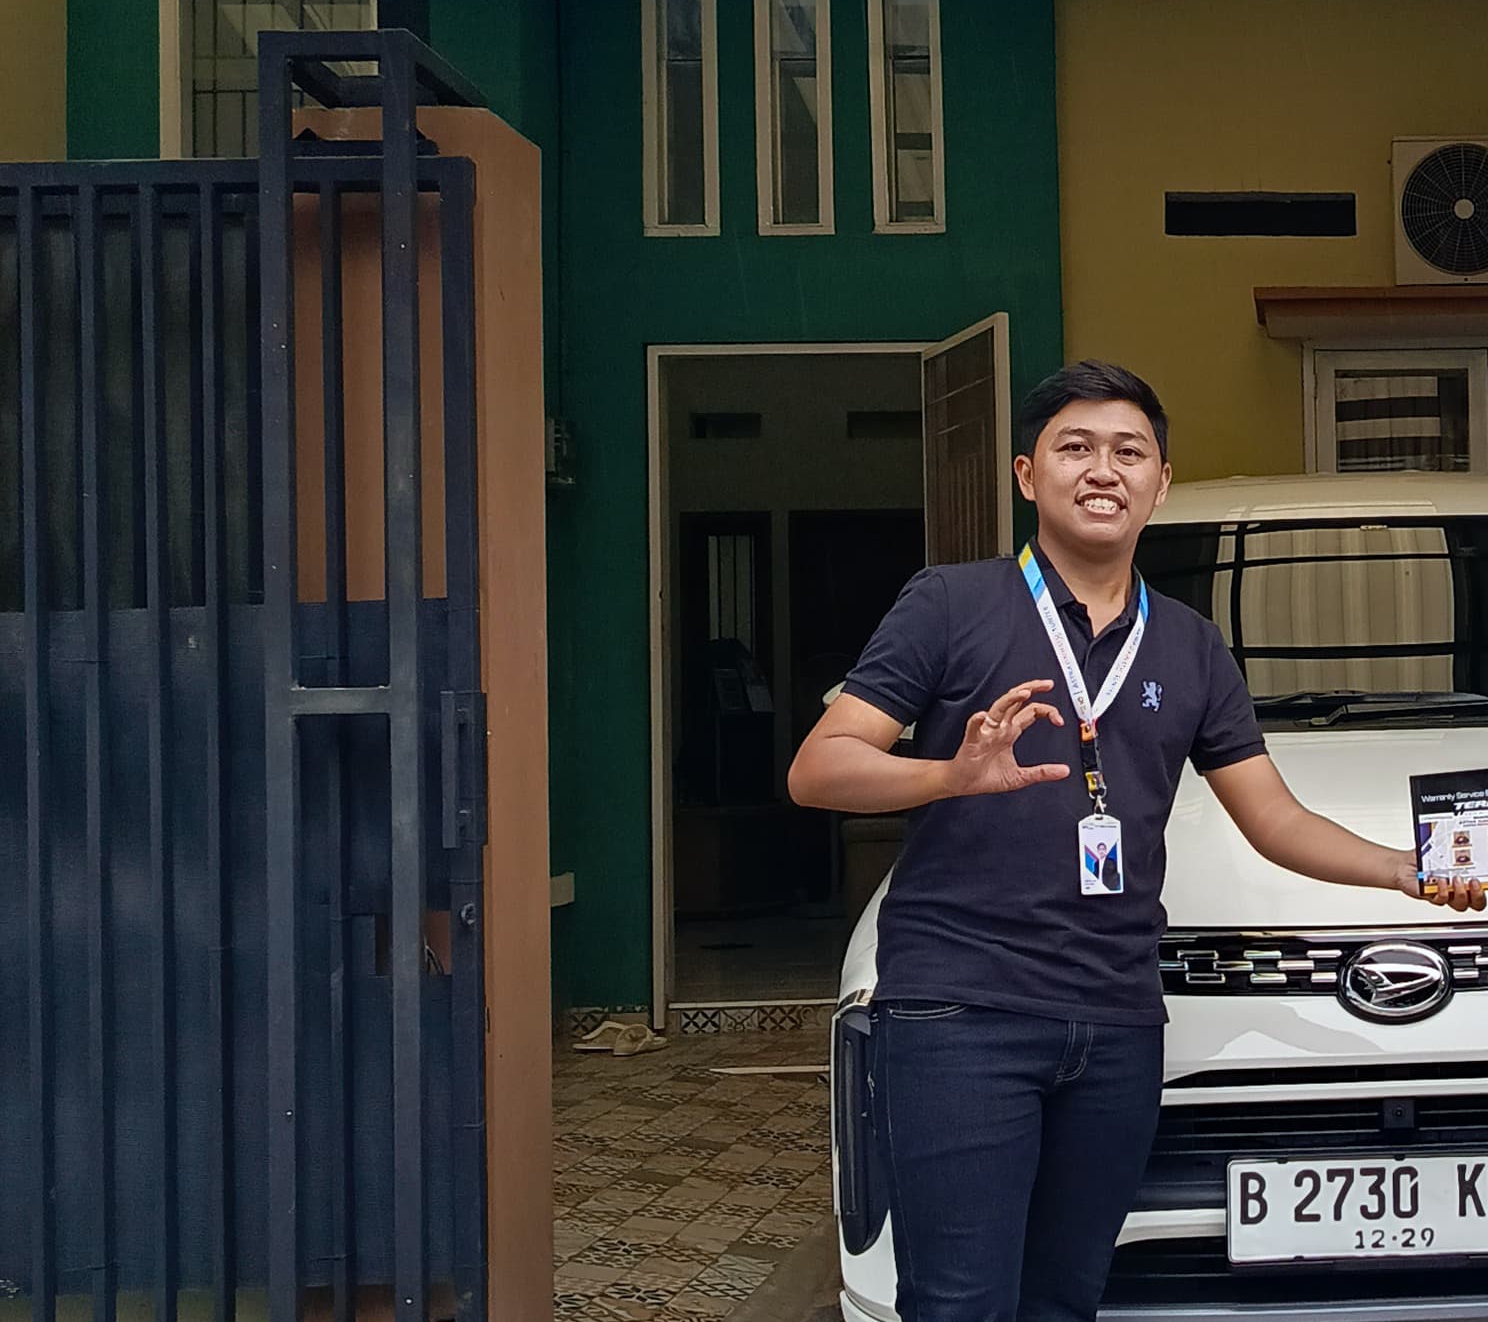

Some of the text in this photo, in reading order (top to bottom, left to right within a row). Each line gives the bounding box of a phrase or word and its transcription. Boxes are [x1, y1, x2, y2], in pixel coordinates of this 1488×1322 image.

[1421, 793, 1455, 803] Warranty
[1456, 790, 1484, 800] Service
[1239, 1171, 1268, 1225] B
[1293, 1165, 1420, 1222] 2730
